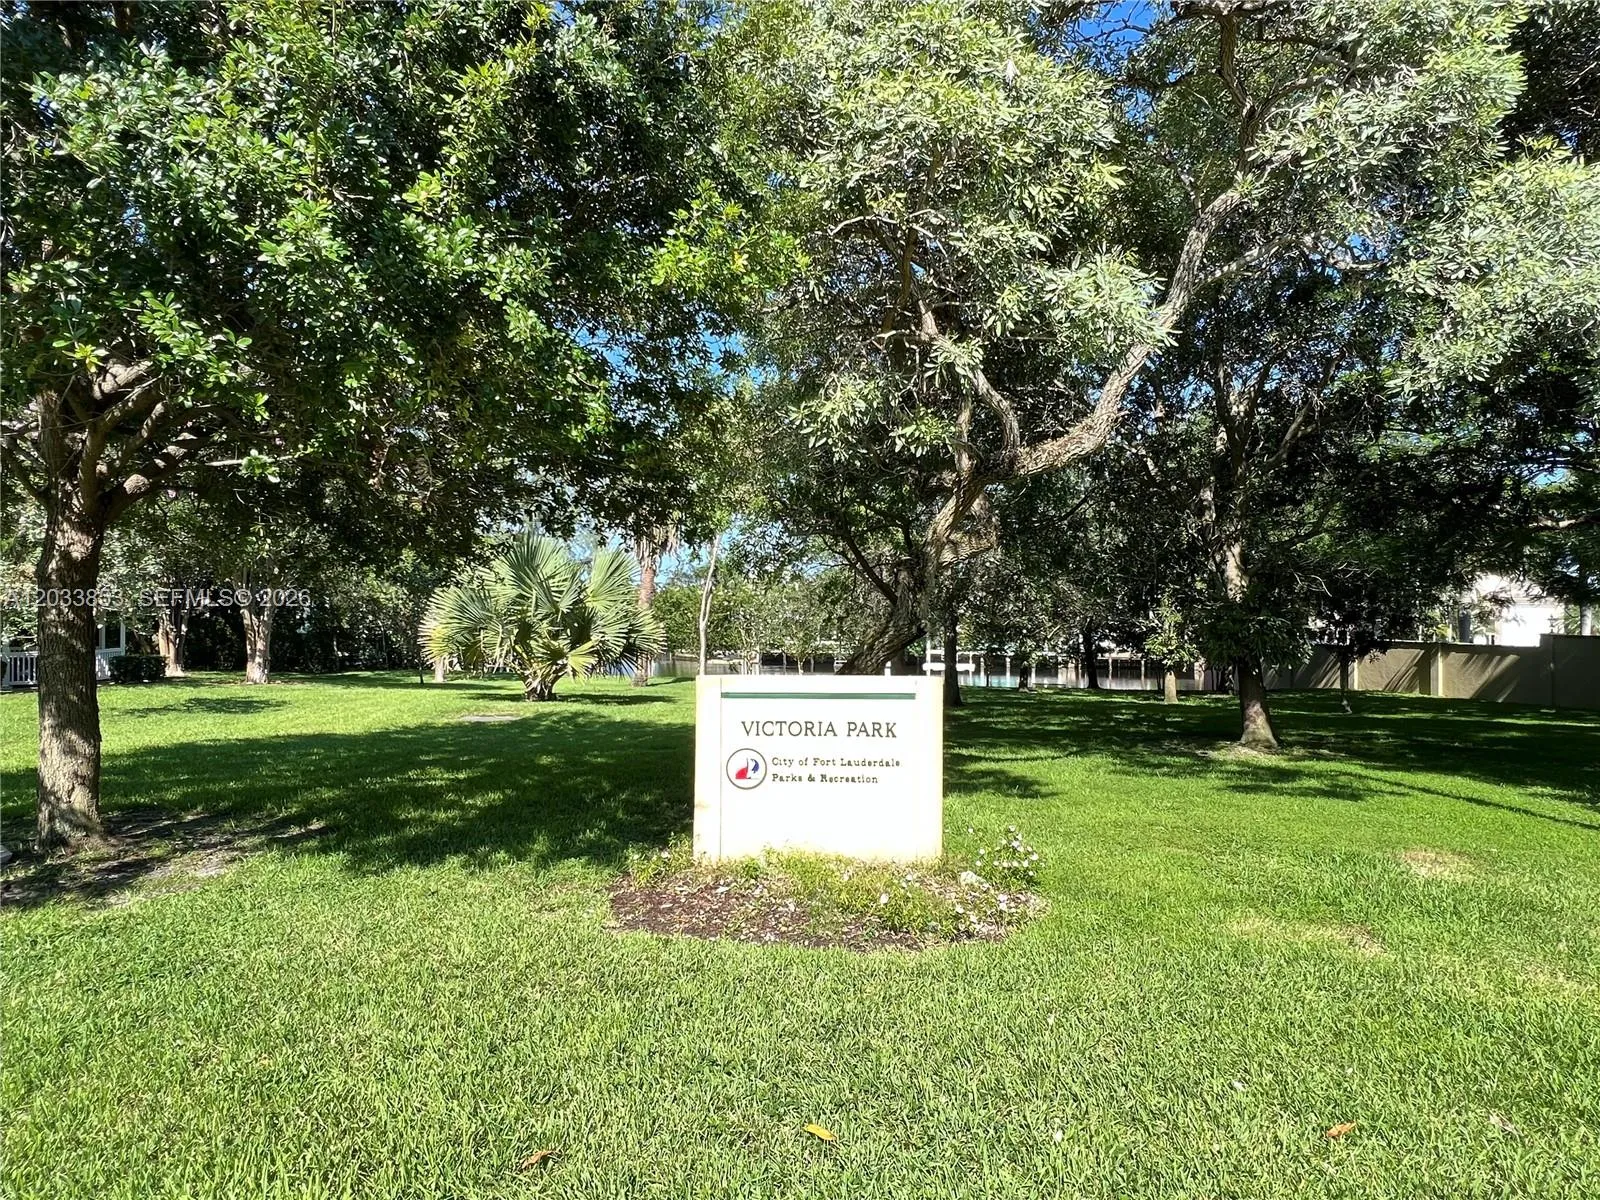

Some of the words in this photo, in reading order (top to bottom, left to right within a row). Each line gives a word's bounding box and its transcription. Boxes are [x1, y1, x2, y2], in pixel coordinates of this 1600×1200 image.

[741, 720, 838, 737] VICTORIA
[846, 721, 898, 738] PARK
[771, 757, 795, 768] City
[798, 757, 809, 767] of
[812, 757, 837, 767] Fort
[840, 757, 901, 768] Lauderdale
[771, 773, 803, 784] Parks
[807, 774, 816, 783] &
[819, 773, 879, 784] Recreation
